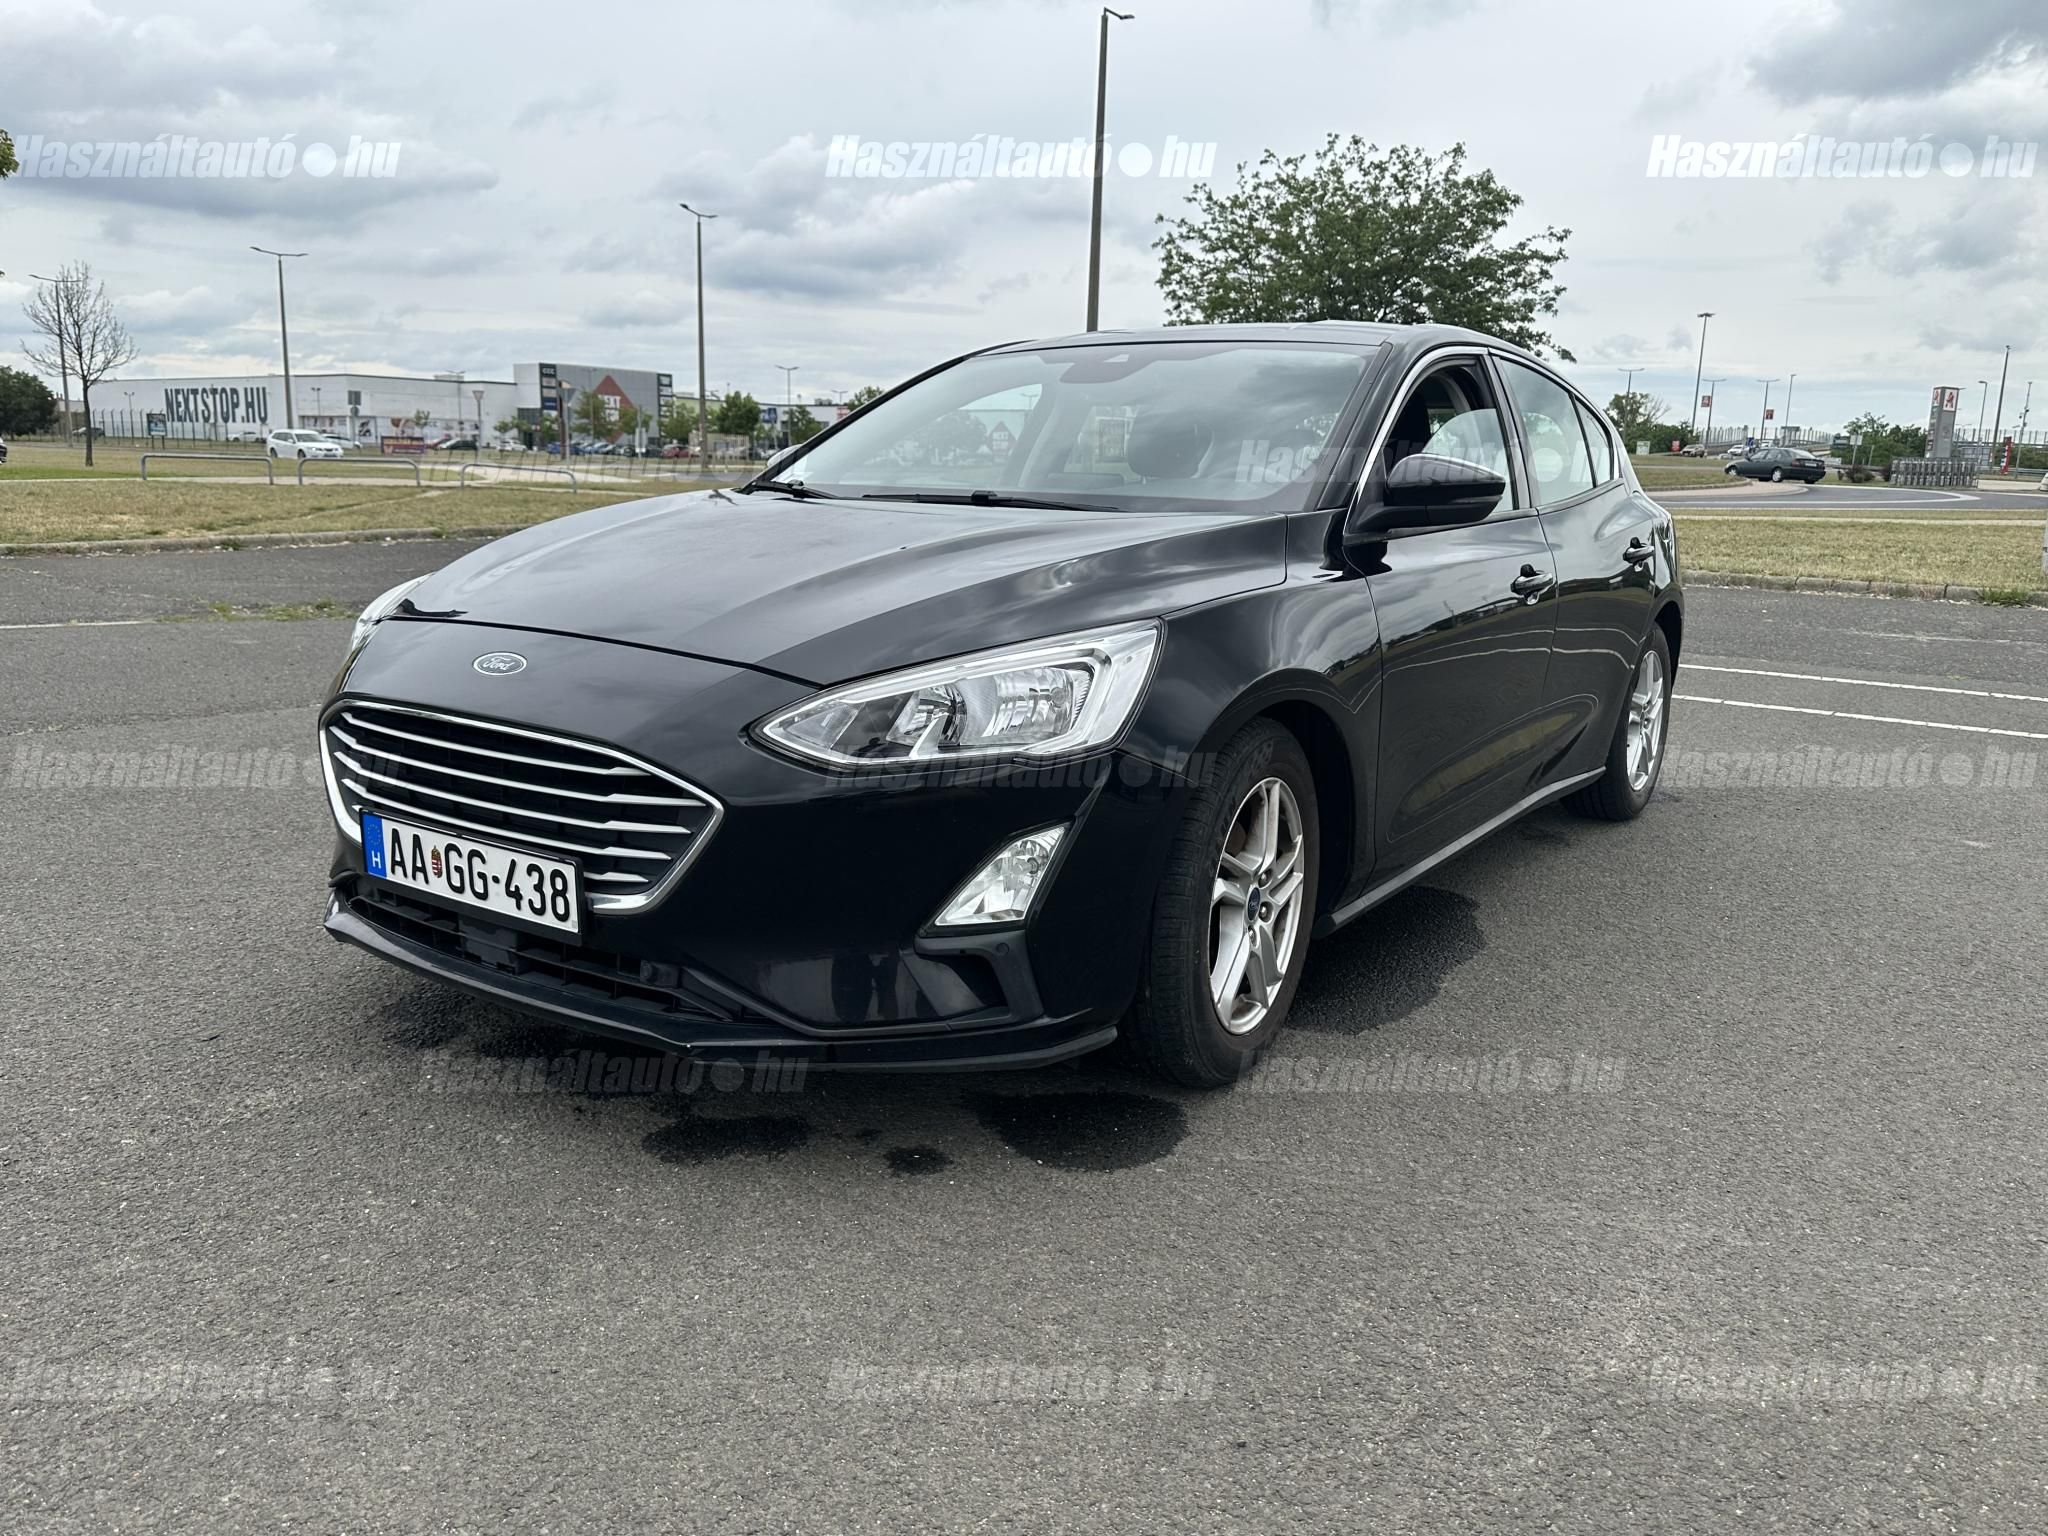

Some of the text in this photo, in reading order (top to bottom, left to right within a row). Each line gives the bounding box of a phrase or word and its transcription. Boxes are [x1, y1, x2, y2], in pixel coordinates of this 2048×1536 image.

[164, 387, 268, 424] NEXTSTOP.HU
[482, 656, 515, 671] Ford
[371, 850, 382, 869] H
